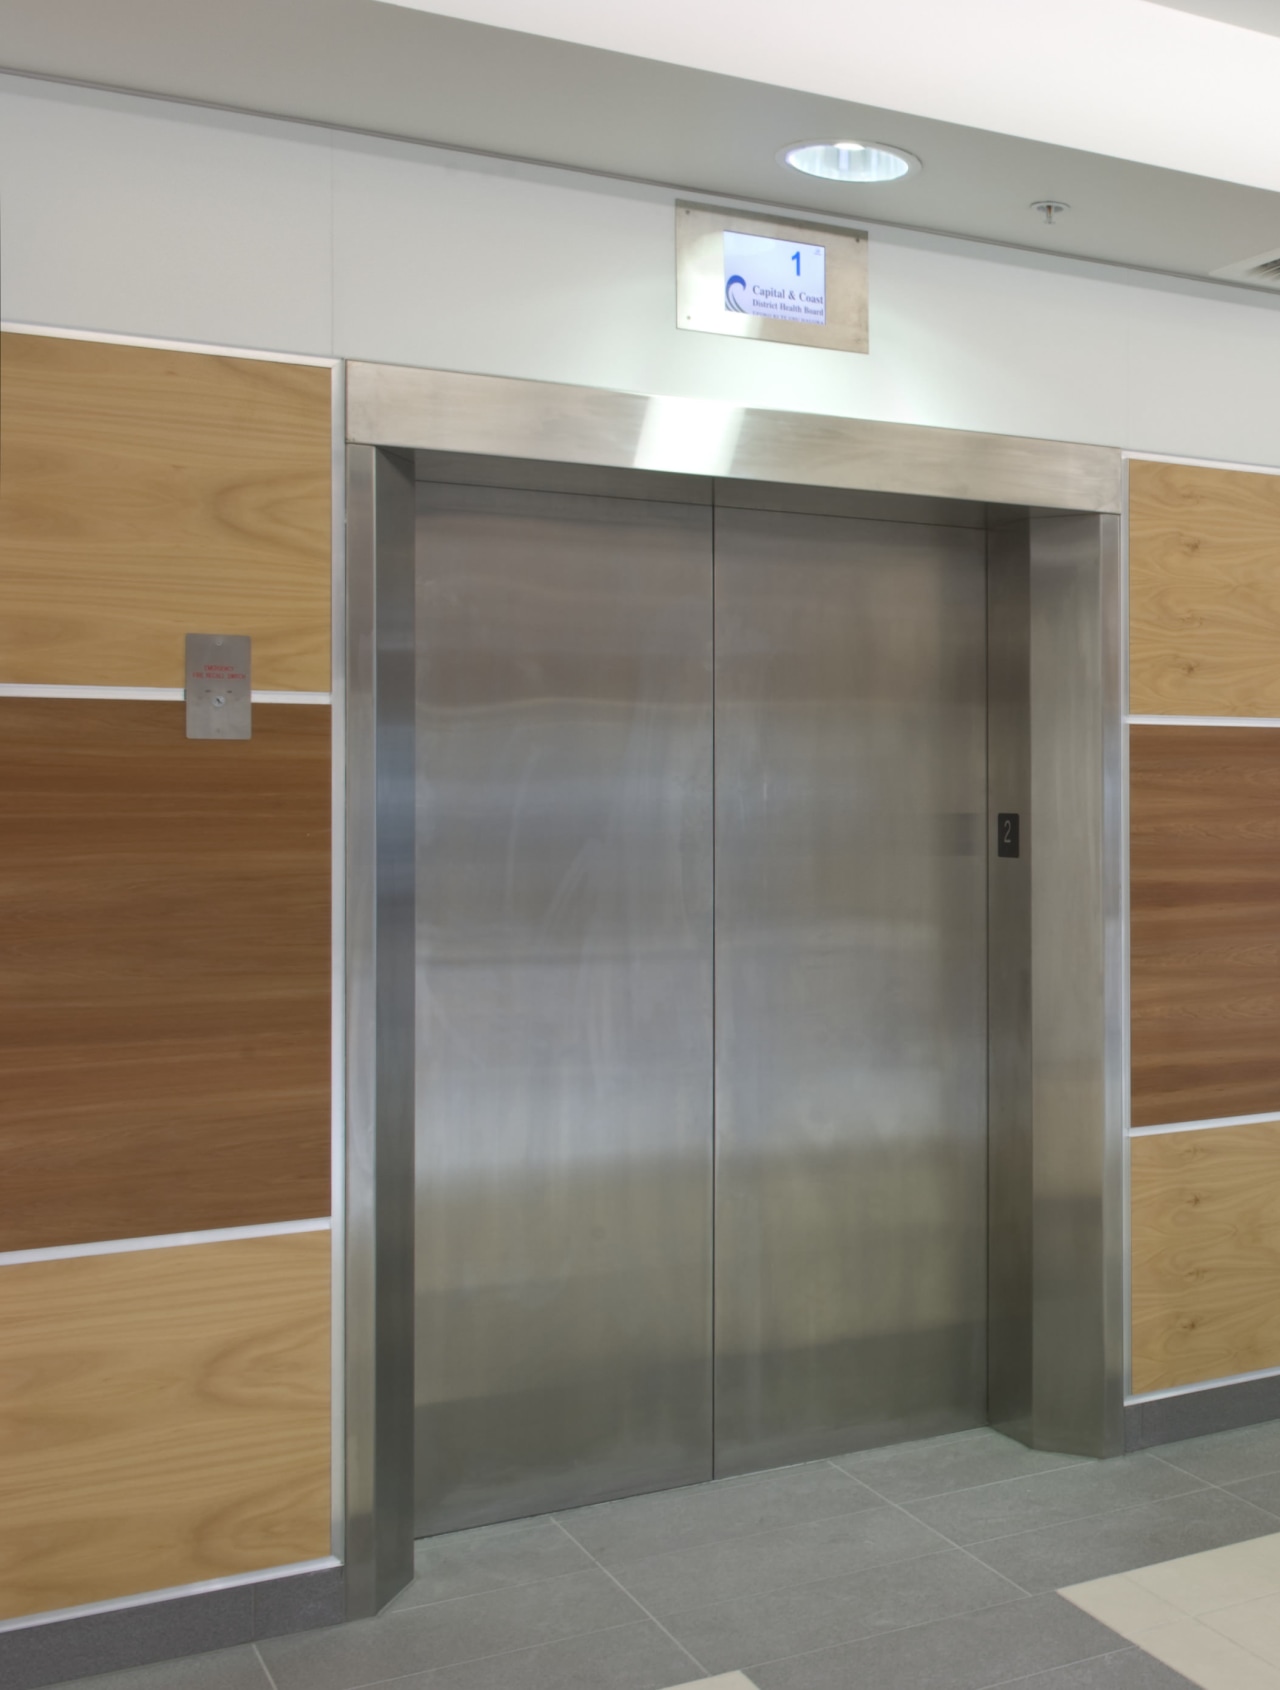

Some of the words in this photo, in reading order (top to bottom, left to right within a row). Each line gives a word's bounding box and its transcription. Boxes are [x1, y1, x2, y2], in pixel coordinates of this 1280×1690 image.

[791, 250, 801, 277] 1
[752, 285, 785, 299] Capital
[788, 290, 796, 301] &
[798, 291, 824, 304] Coast
[752, 298, 778, 310] District
[779, 302, 802, 313] Health
[803, 305, 824, 317] Board
[1003, 819, 1012, 843] 2
